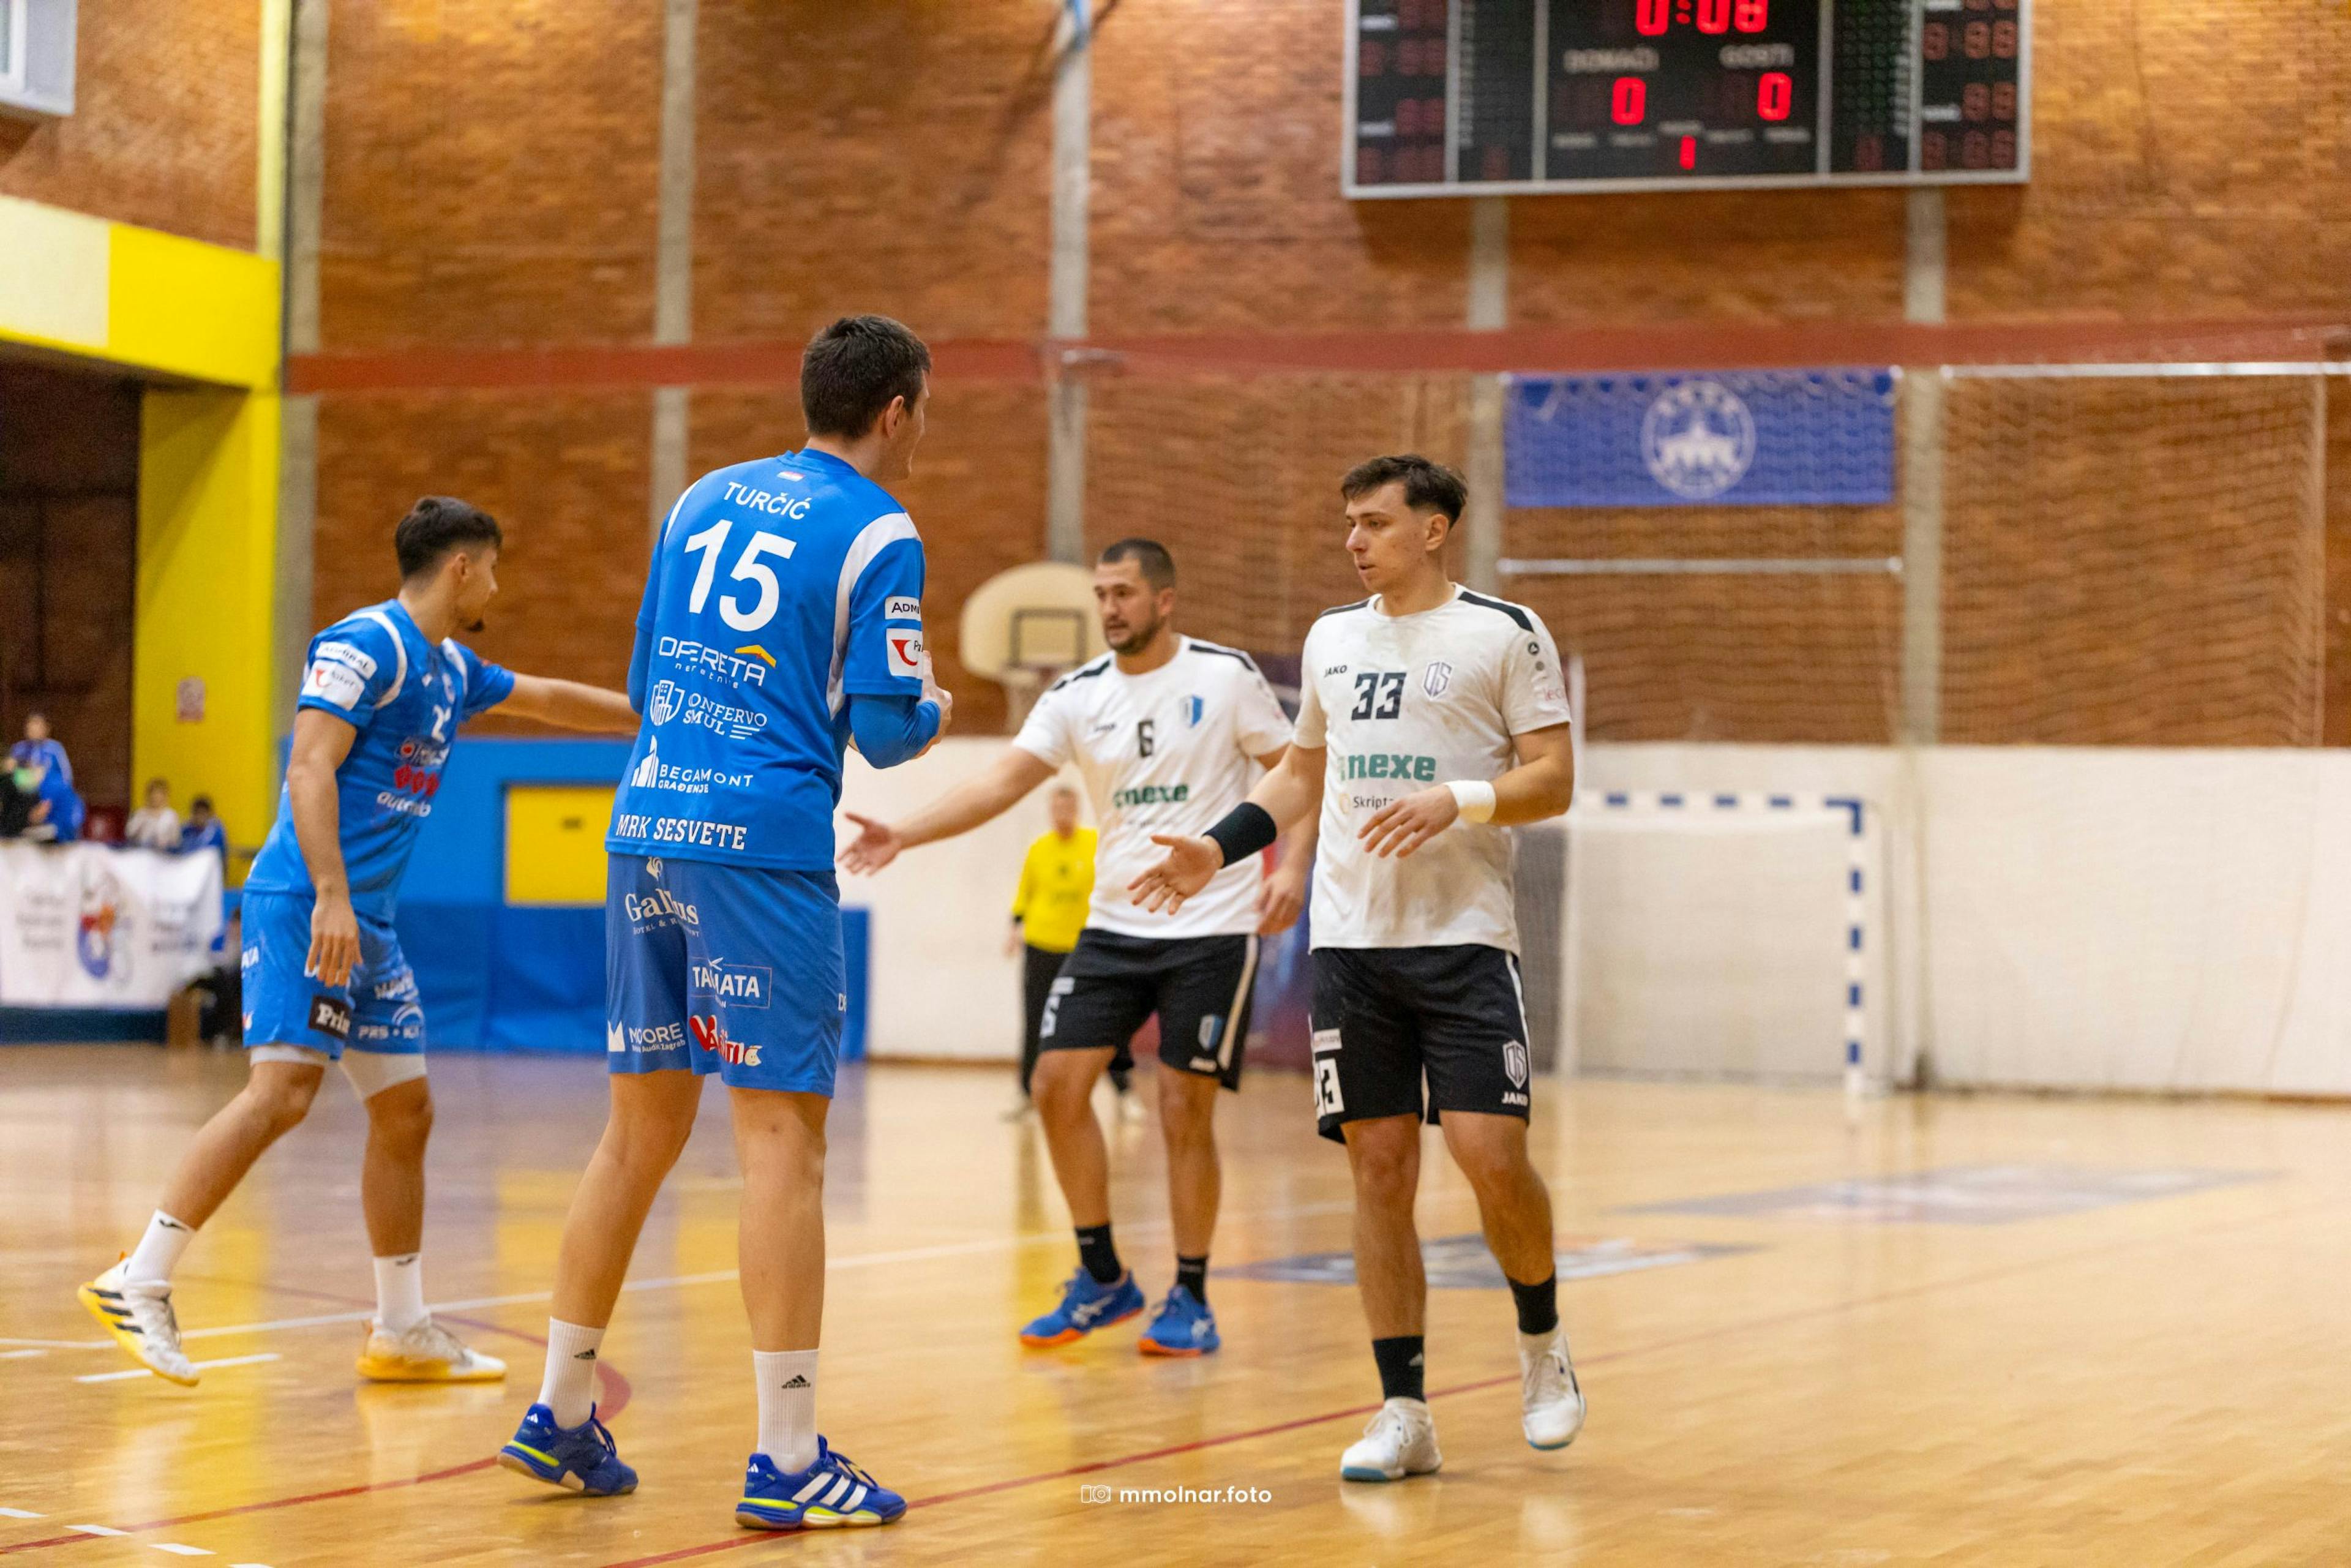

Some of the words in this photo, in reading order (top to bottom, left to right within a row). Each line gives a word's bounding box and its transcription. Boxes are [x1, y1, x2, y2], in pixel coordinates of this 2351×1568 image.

[1611, 77, 1646, 126] 0
[1757, 72, 1793, 121] 0
[1679, 135, 1697, 170] 1
[723, 481, 812, 520] TURČIĆ
[683, 519, 797, 632] 15
[1351, 672, 1408, 721] 33
[1138, 720, 1154, 759] 6
[659, 763, 754, 787] BEGAMONT
[1348, 754, 1436, 782] nexe
[1353, 795, 1394, 810] Skript
[616, 814, 651, 838] MRK
[653, 817, 748, 850] SESVETE
[625, 888, 699, 925] Gallus
[629, 1022, 683, 1045] MOORE
